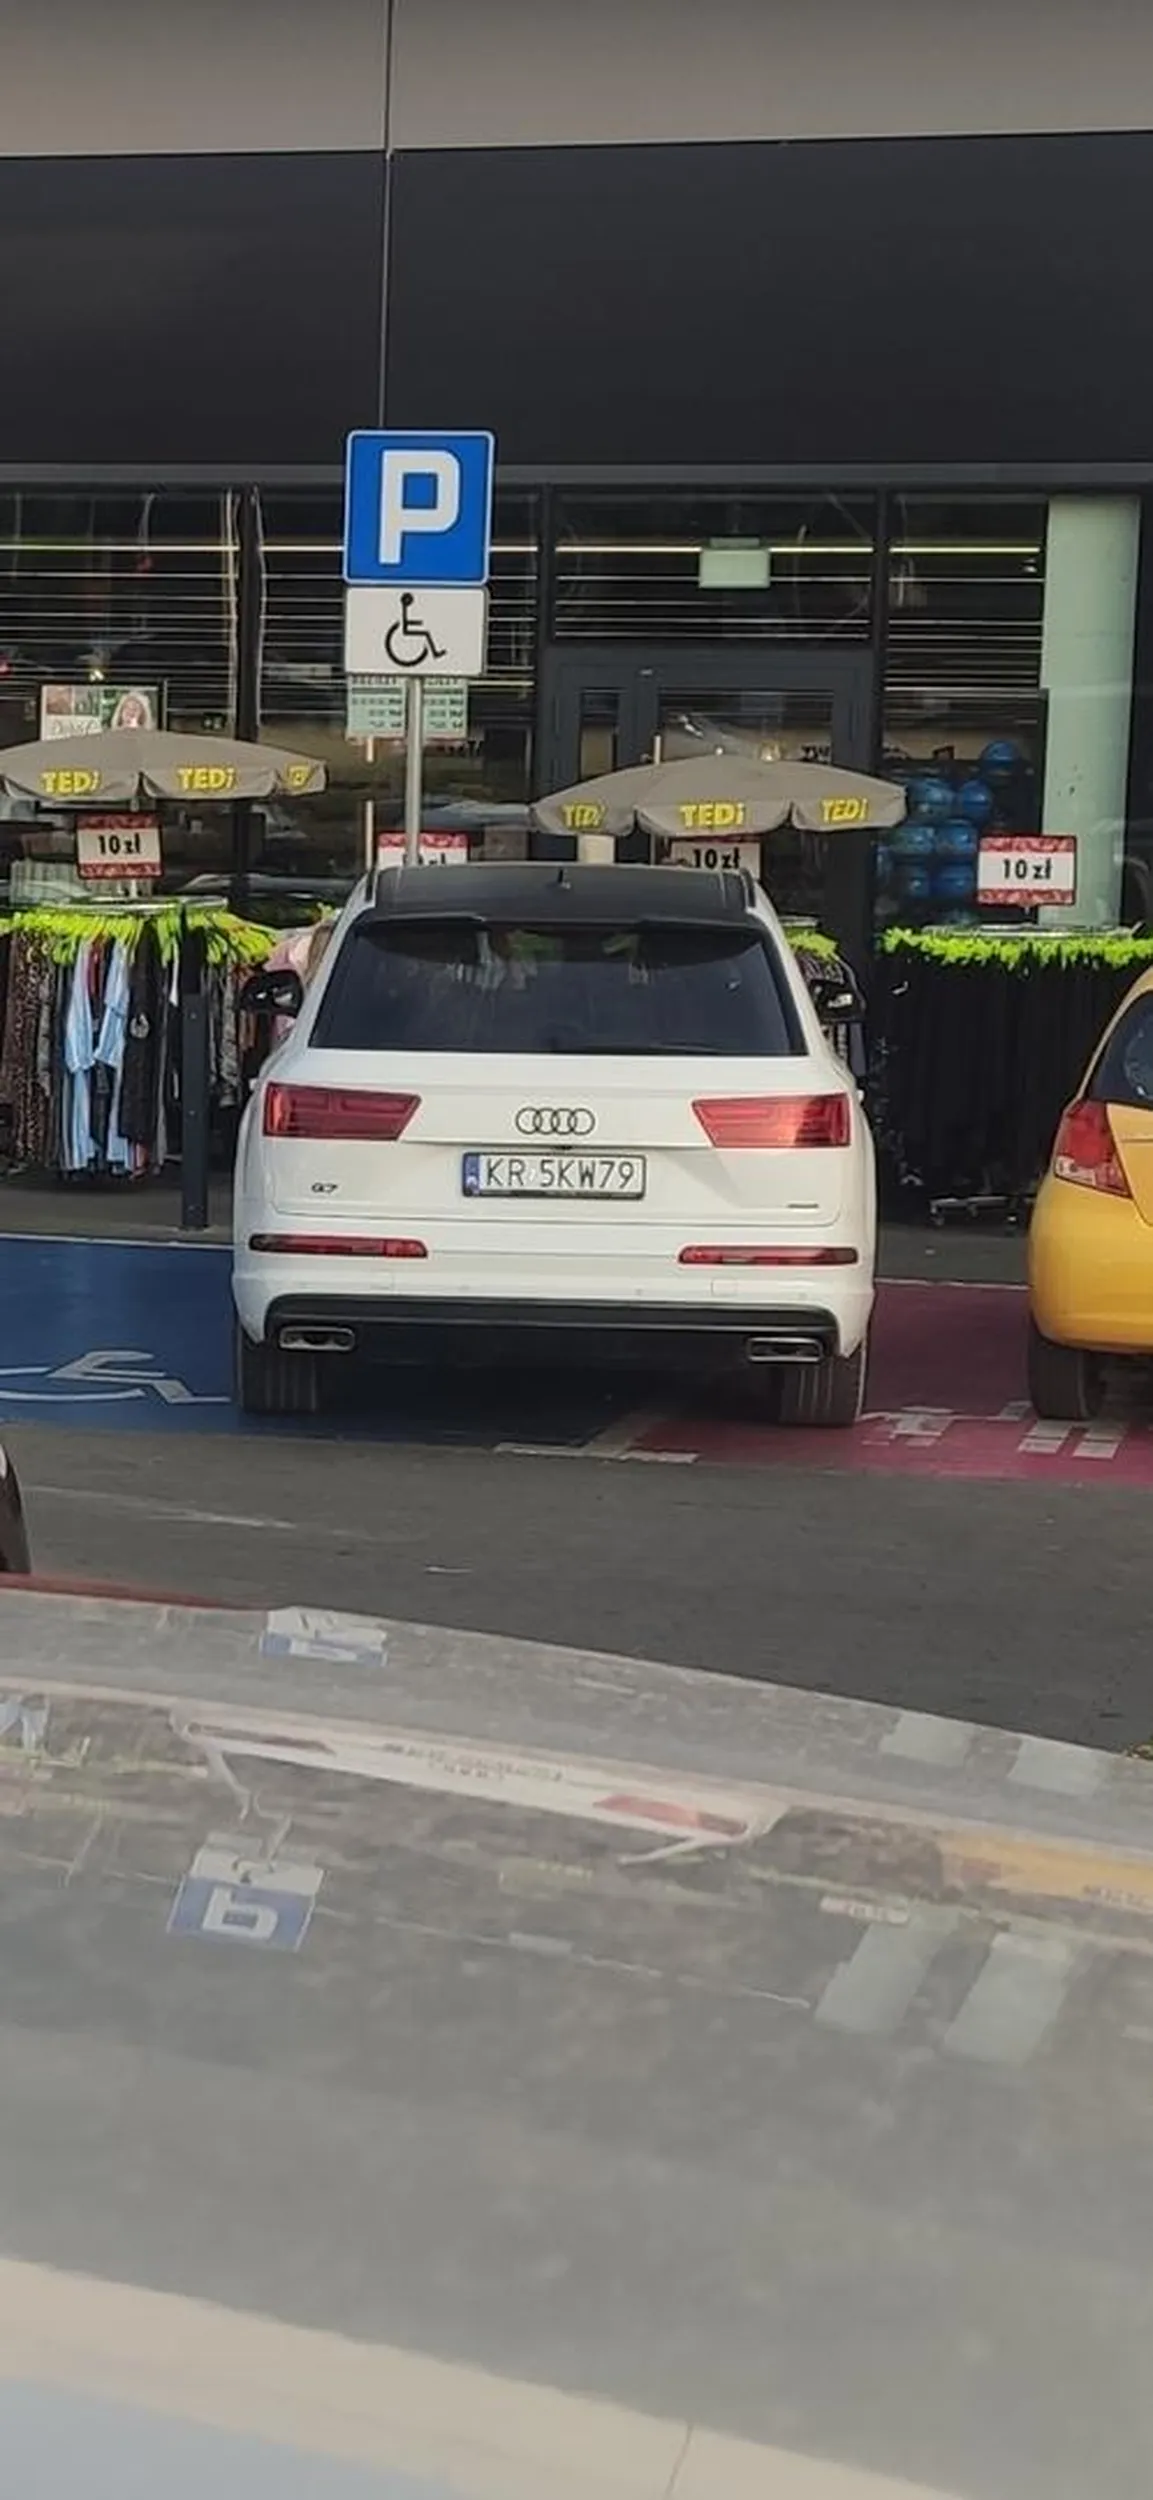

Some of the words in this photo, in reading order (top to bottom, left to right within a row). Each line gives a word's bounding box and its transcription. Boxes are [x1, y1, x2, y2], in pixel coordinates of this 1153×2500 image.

[379, 449, 460, 564] P
[41, 771, 99, 794] TEDi
[177, 767, 236, 791] TEDi
[680, 803, 746, 828] TEDi
[821, 798, 867, 822] TEDi
[98, 834, 121, 855] 10
[693, 848, 718, 869] 10
[722, 846, 741, 869] zł
[1003, 858, 1028, 879] 10
[1033, 857, 1053, 879] zł
[486, 1158, 526, 1187] KR
[539, 1159, 635, 1189] 5KW79
